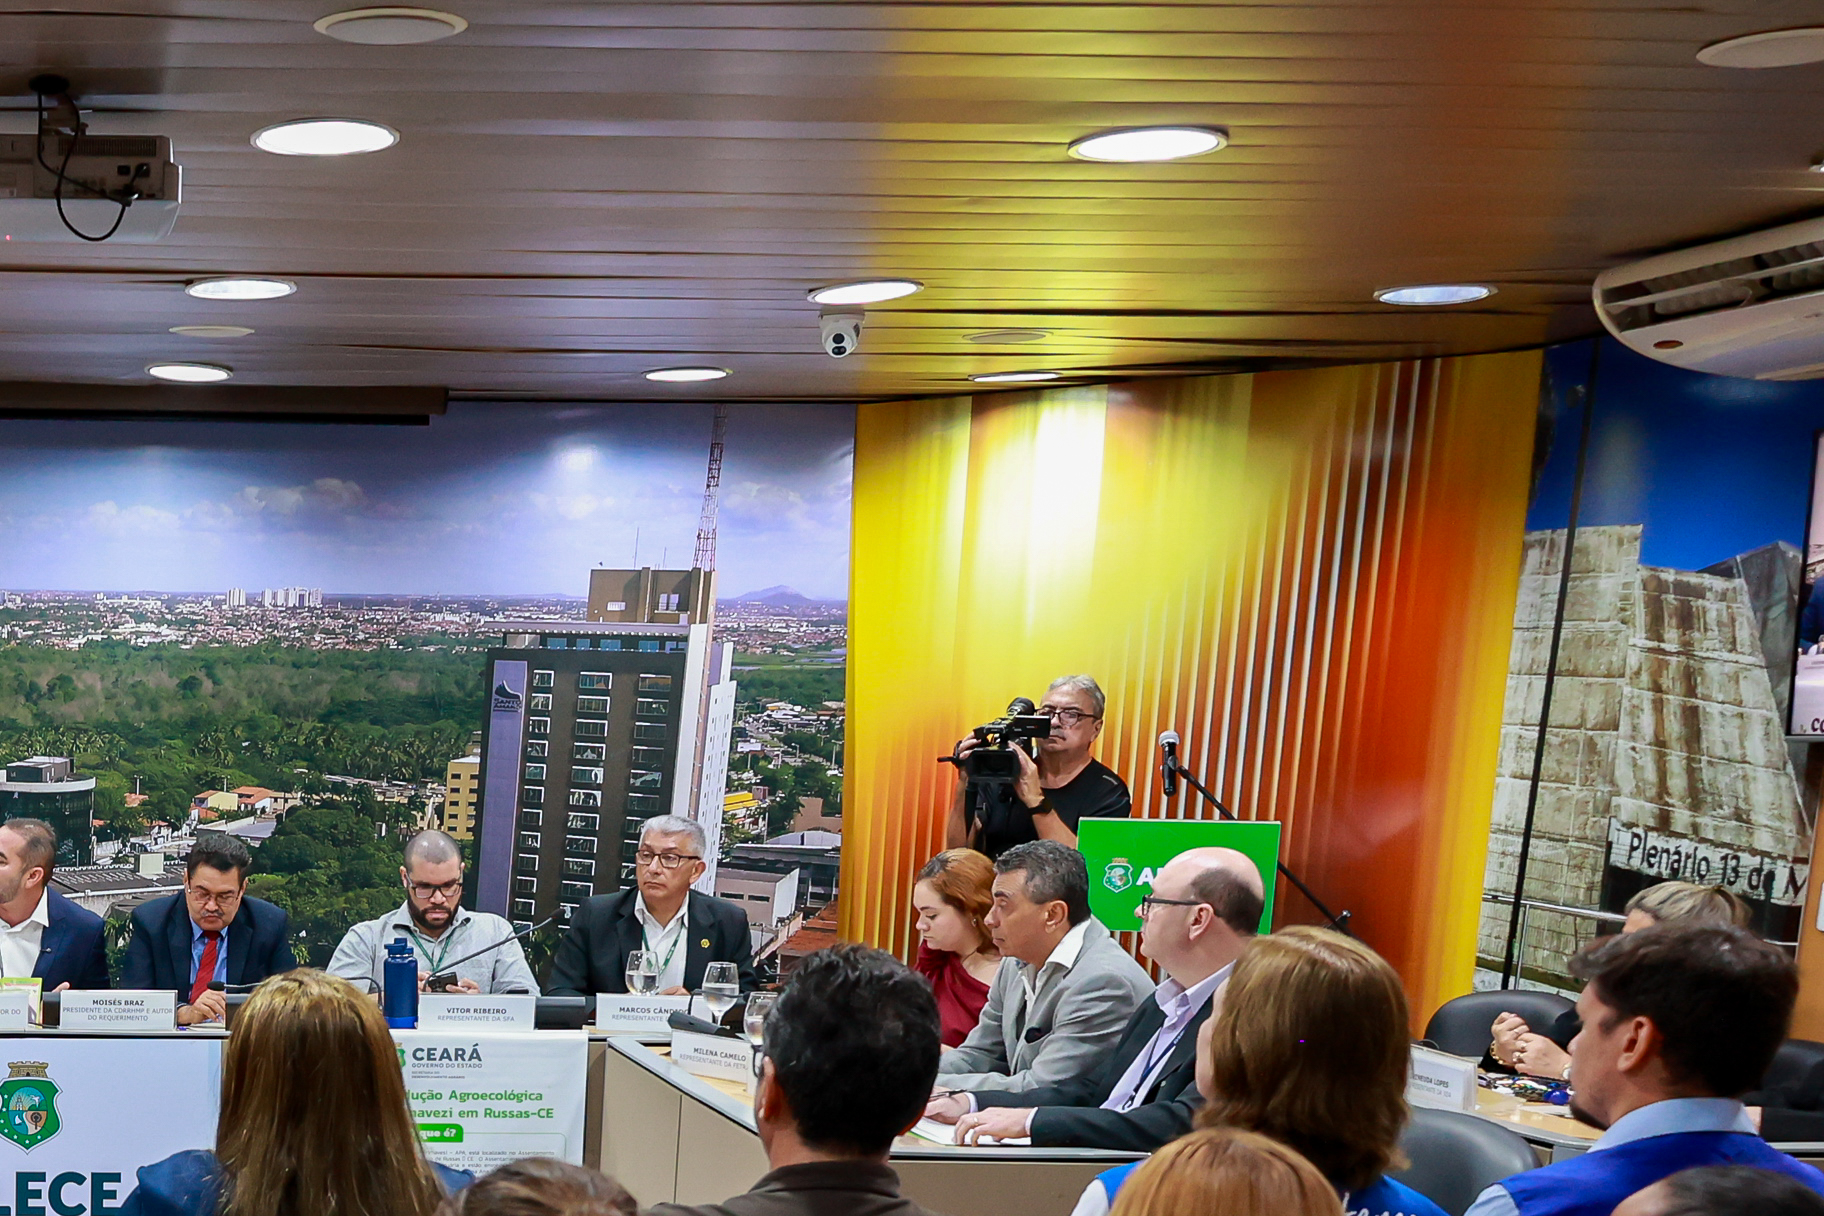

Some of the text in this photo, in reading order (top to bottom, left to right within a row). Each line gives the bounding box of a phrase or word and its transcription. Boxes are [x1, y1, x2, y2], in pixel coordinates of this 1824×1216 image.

[1721, 853, 1741, 886] 13
[92, 998, 122, 1006] MOISÉS
[612, 1014, 663, 1022] REPRESENTANTE
[412, 1043, 482, 1061] CEARÁ
[693, 1047, 747, 1062] MILENA CAMELO
[680, 1053, 723, 1067] REPRESENTANTE
[448, 1089, 543, 1103] Agroecológica
[458, 1110, 478, 1118] em
[483, 1108, 554, 1118] Russas-CE
[419, 1127, 457, 1140] que é?
